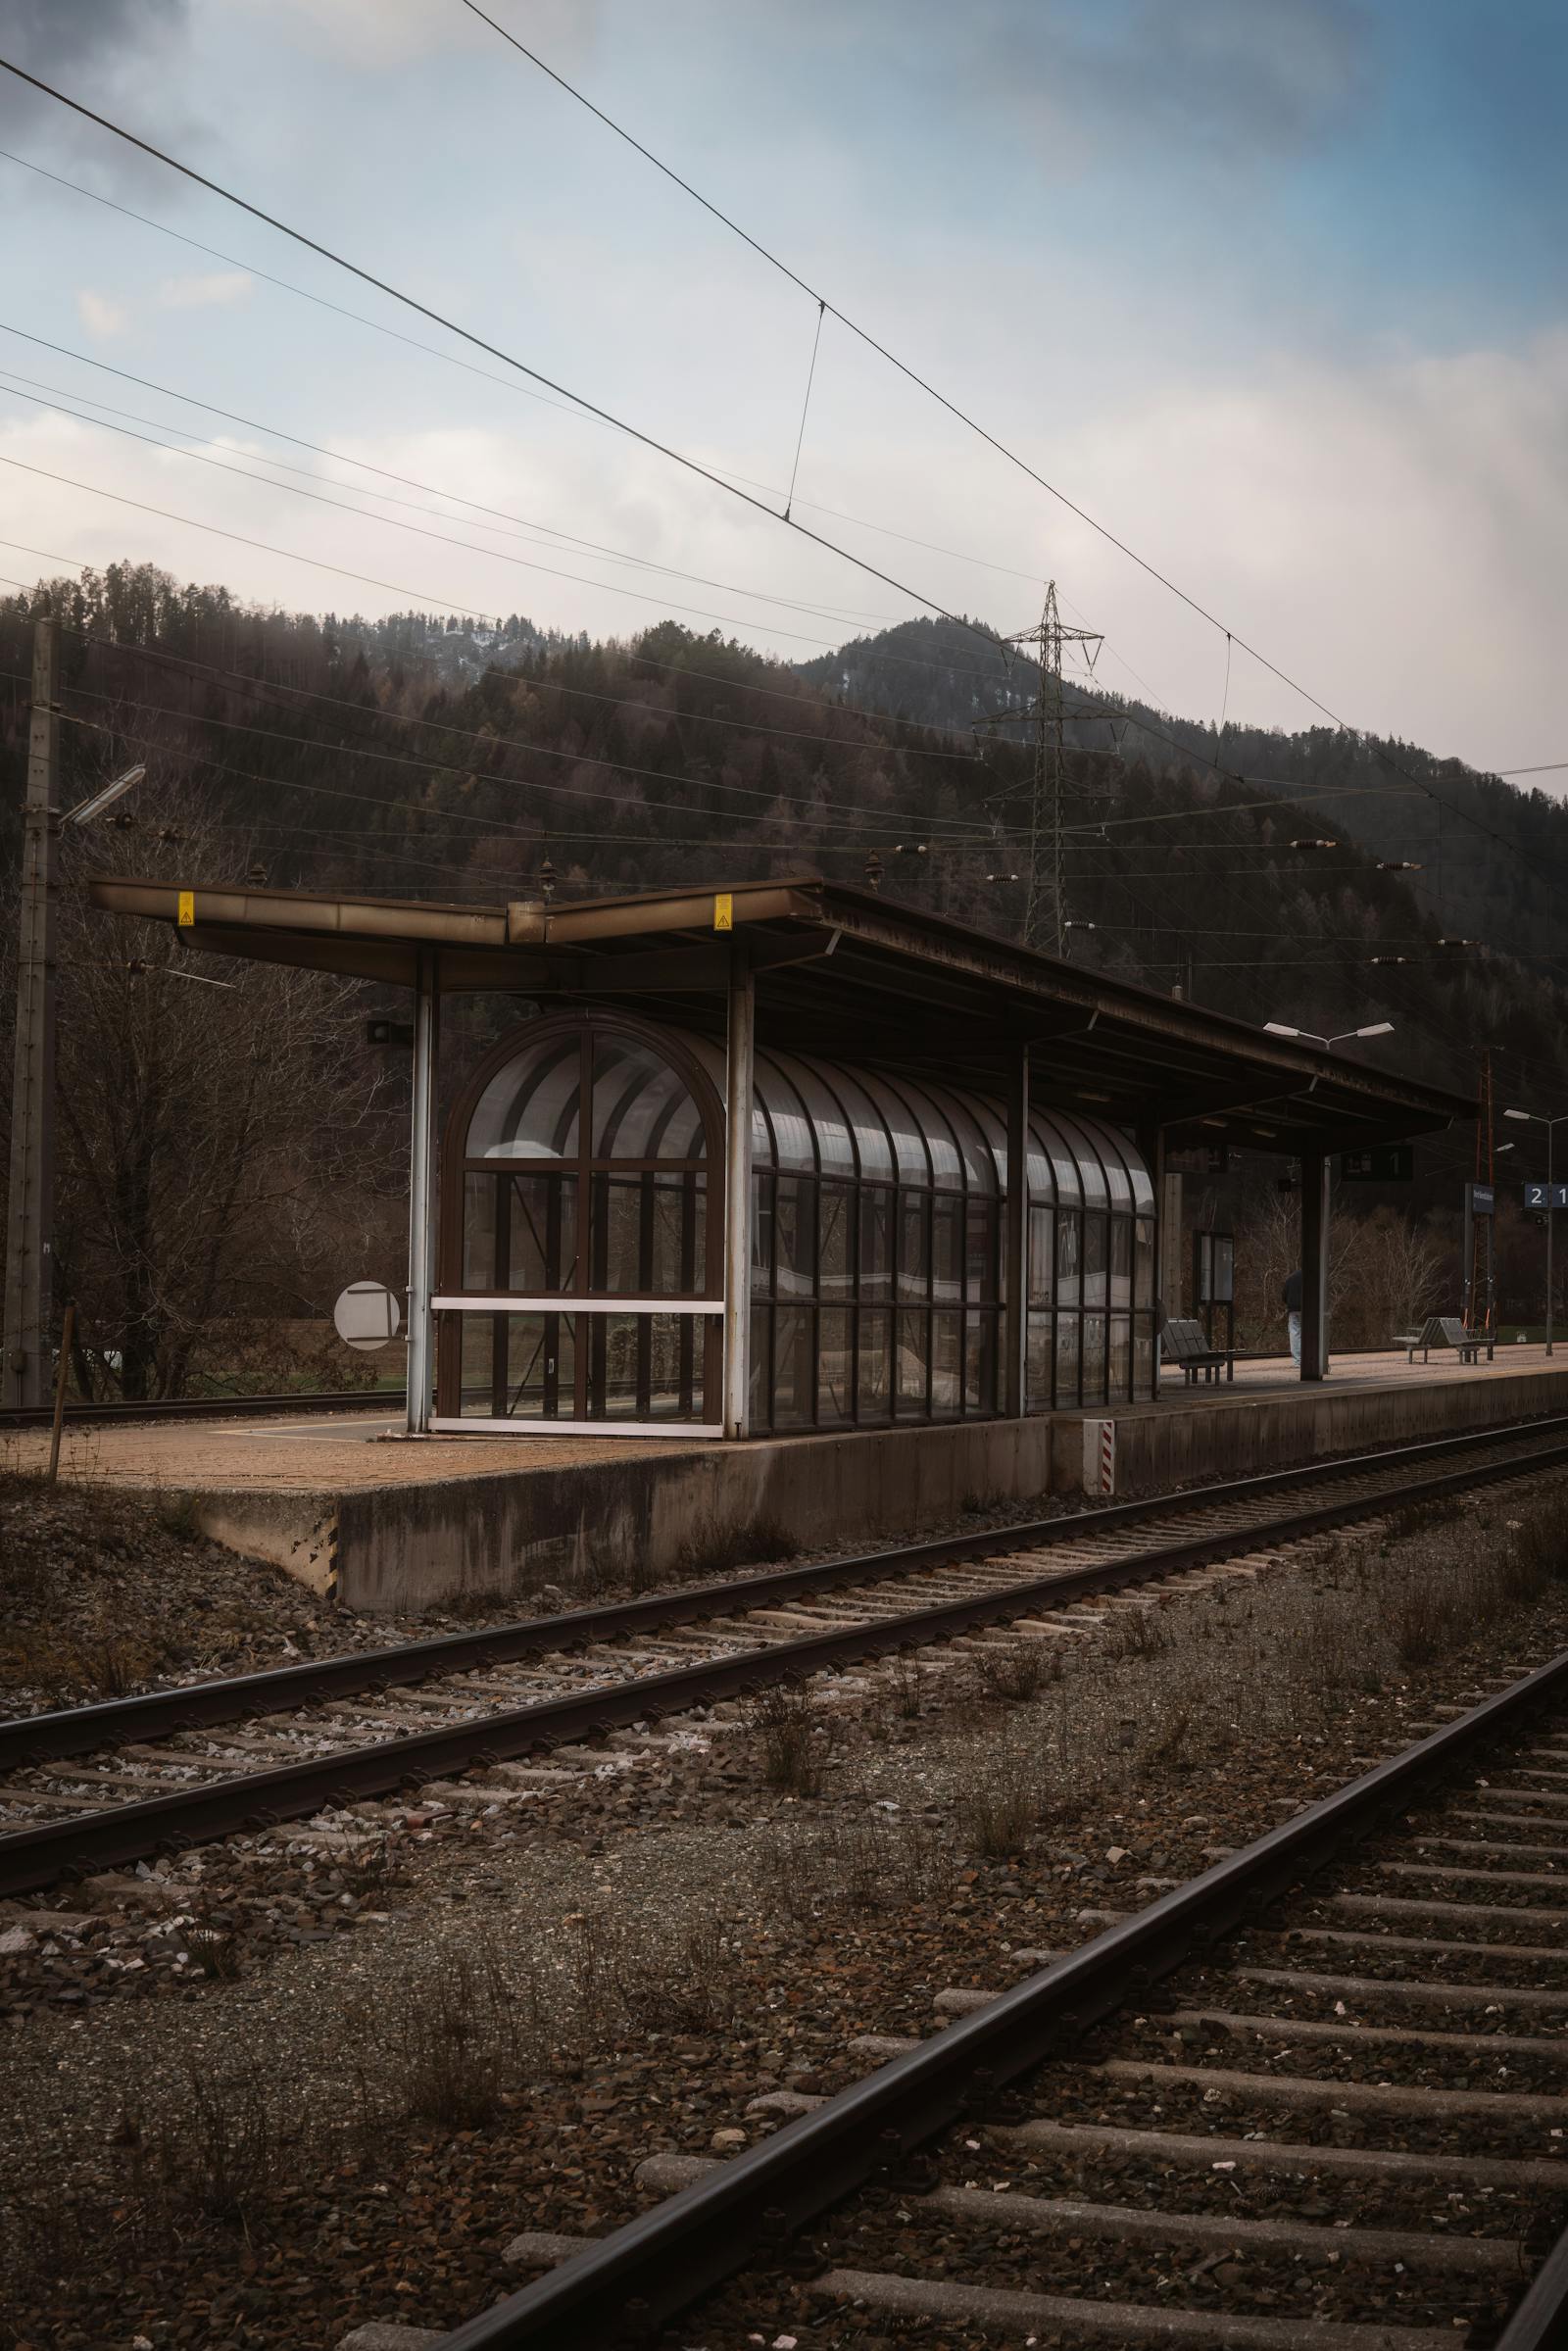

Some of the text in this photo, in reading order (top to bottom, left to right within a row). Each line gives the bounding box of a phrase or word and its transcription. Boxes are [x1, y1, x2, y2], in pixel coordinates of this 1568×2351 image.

[1390, 1152, 1399, 1175] 1
[1531, 1188, 1567, 1203] 2 1
